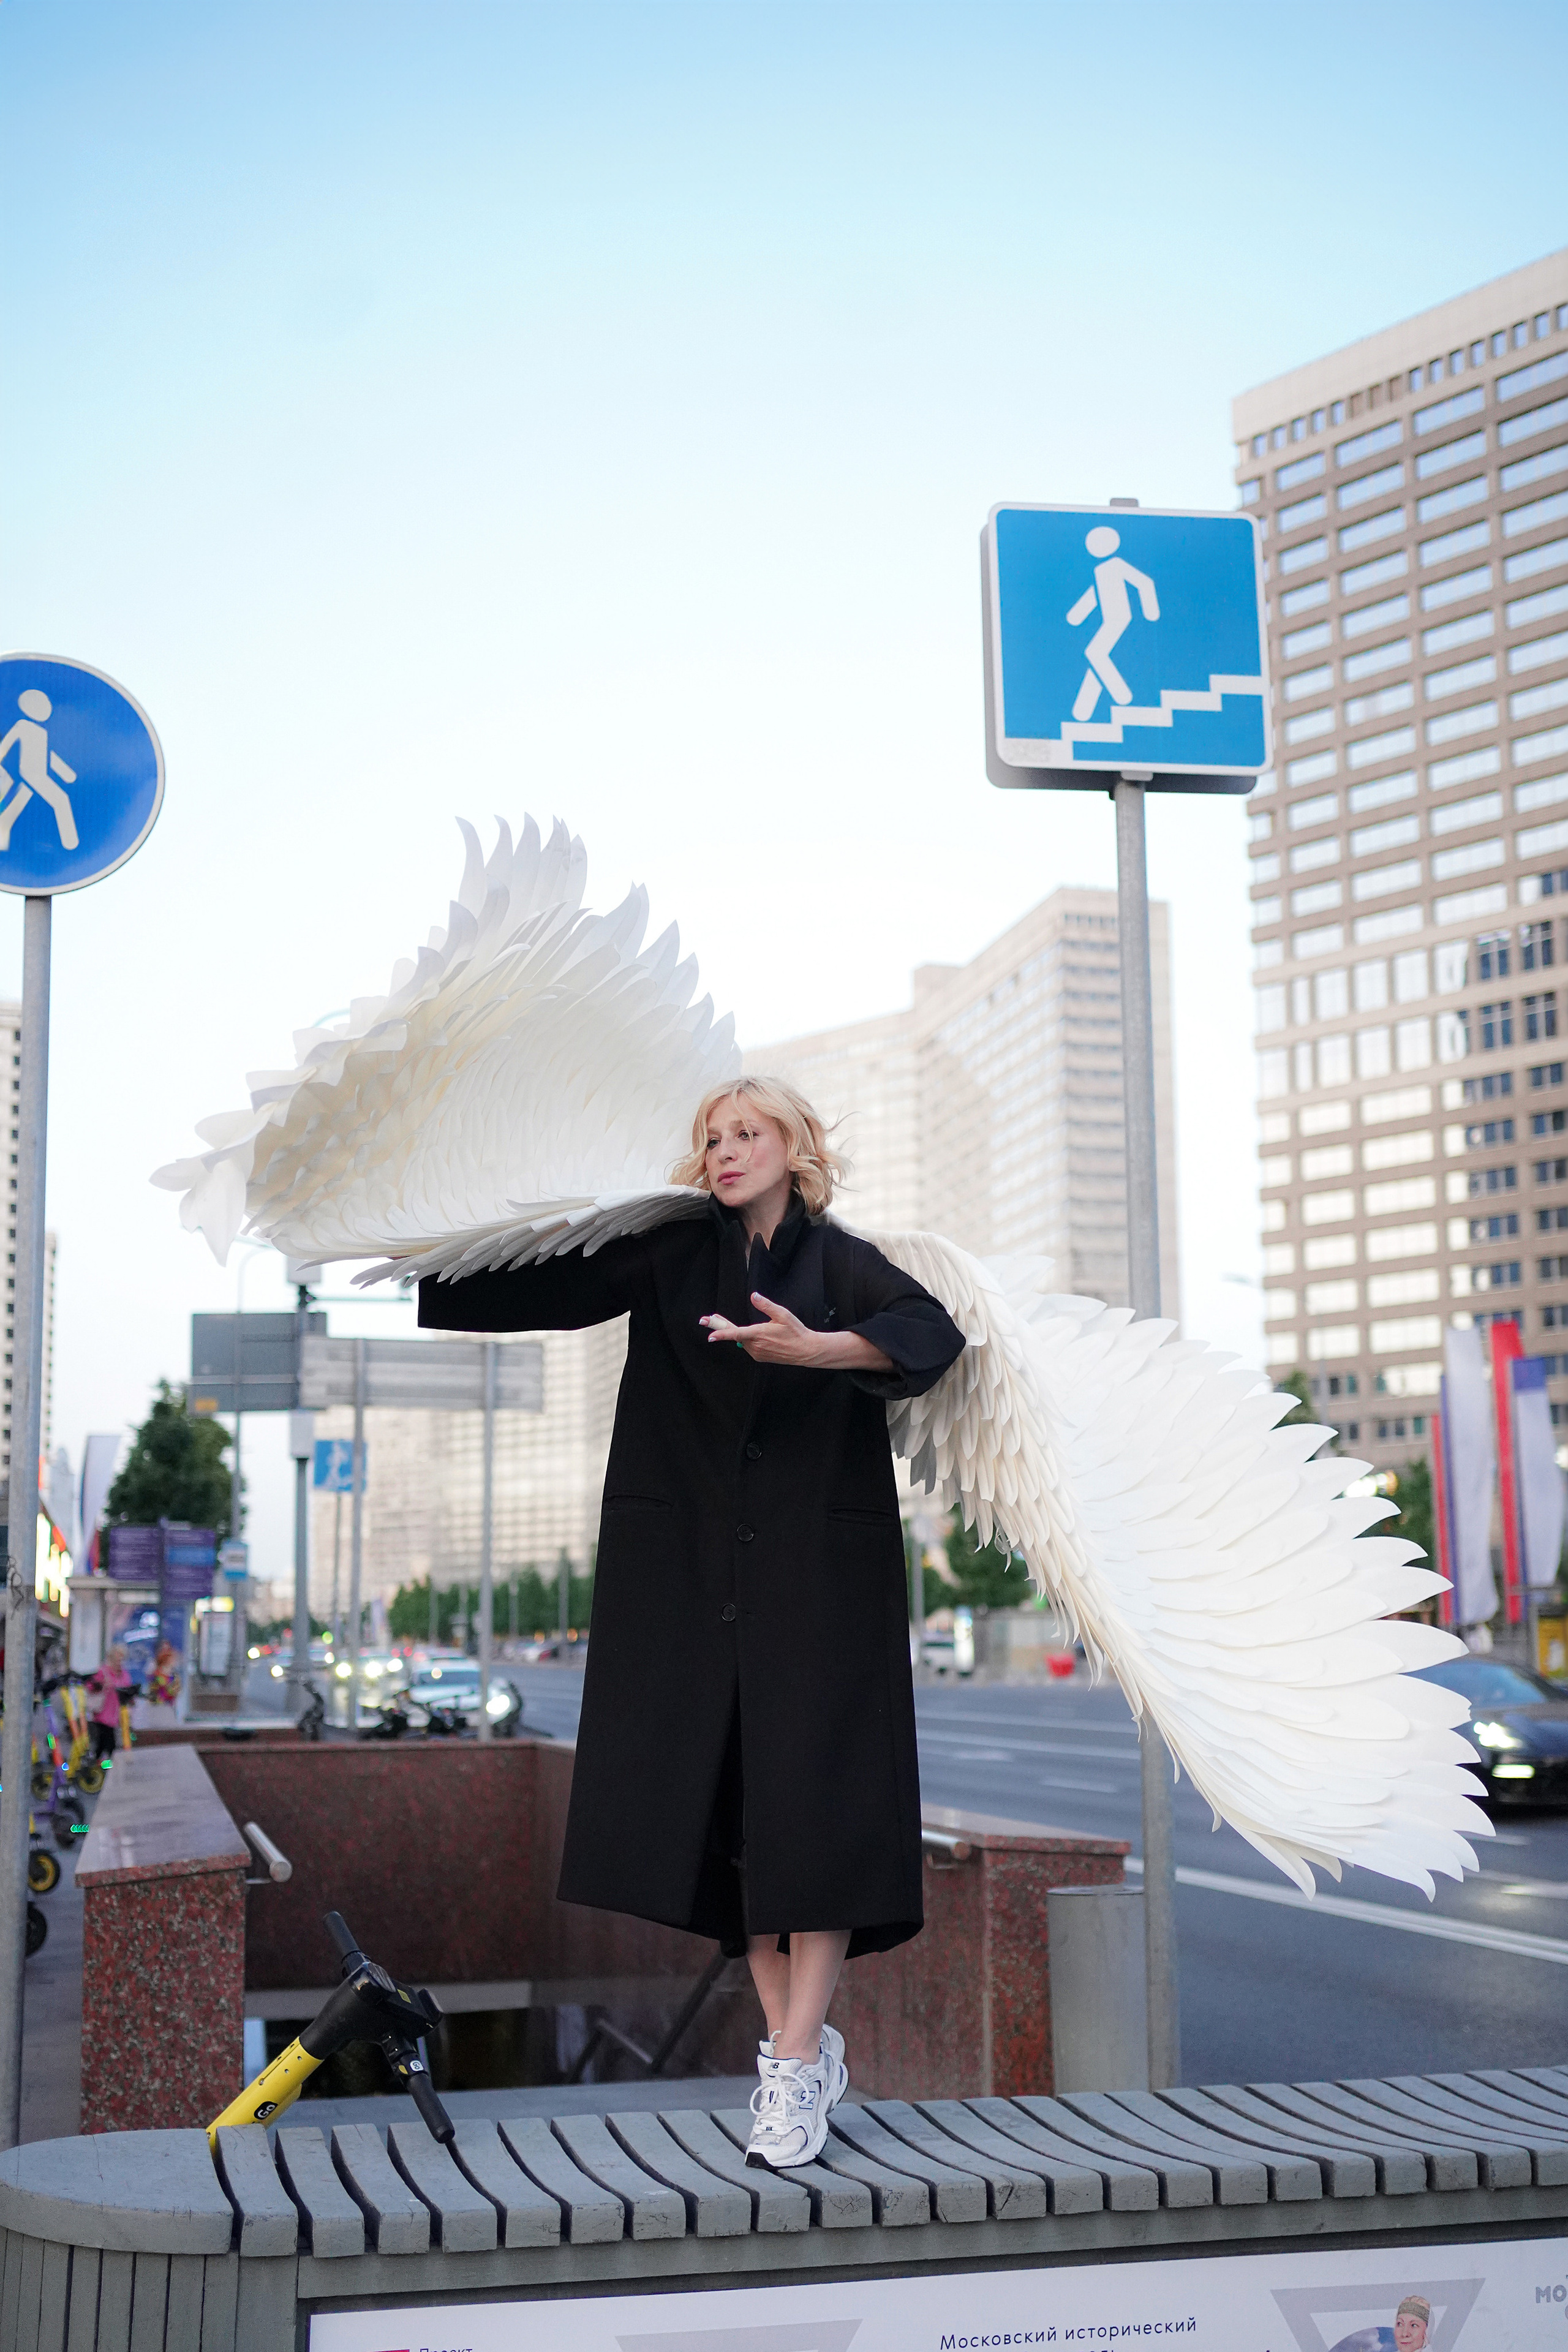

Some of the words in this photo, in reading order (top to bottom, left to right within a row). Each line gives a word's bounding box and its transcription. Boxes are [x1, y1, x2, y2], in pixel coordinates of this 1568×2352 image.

[412, 2061, 421, 2070] Go
[257, 2104, 276, 2119] Go
[940, 2326, 1057, 2350] Московский
[1065, 2316, 1196, 2341] исторический
